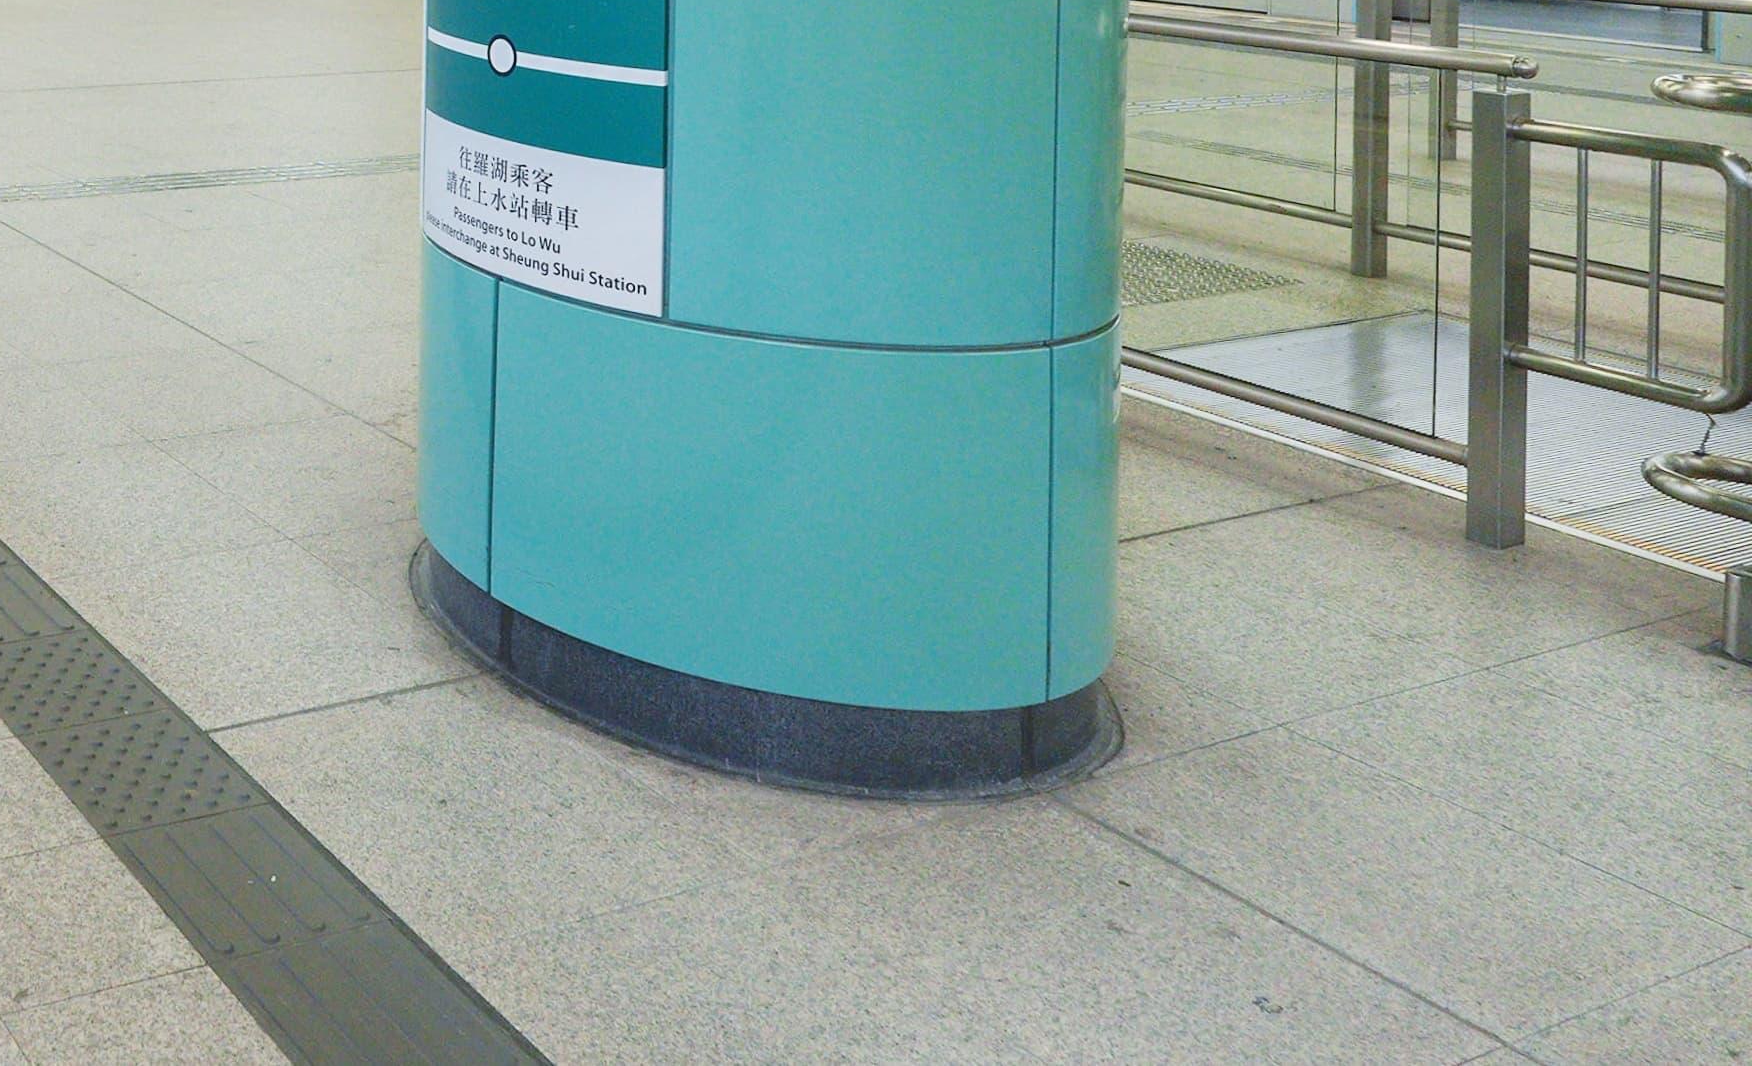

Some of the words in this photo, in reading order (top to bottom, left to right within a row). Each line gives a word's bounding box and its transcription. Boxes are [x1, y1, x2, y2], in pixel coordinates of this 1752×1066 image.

[459, 145, 553, 195] 往羅湖乘客
[446, 168, 579, 231] 請在上水站轉車
[441, 218, 488, 253] interchange
[489, 244, 500, 257] at
[502, 246, 549, 276] Sheung
[553, 261, 585, 282] Shui
[589, 271, 647, 295] Station
[453, 205, 504, 238] Passengers
[506, 227, 519, 242] to
[521, 231, 536, 247] Lo
[539, 235, 561, 254] Wu
